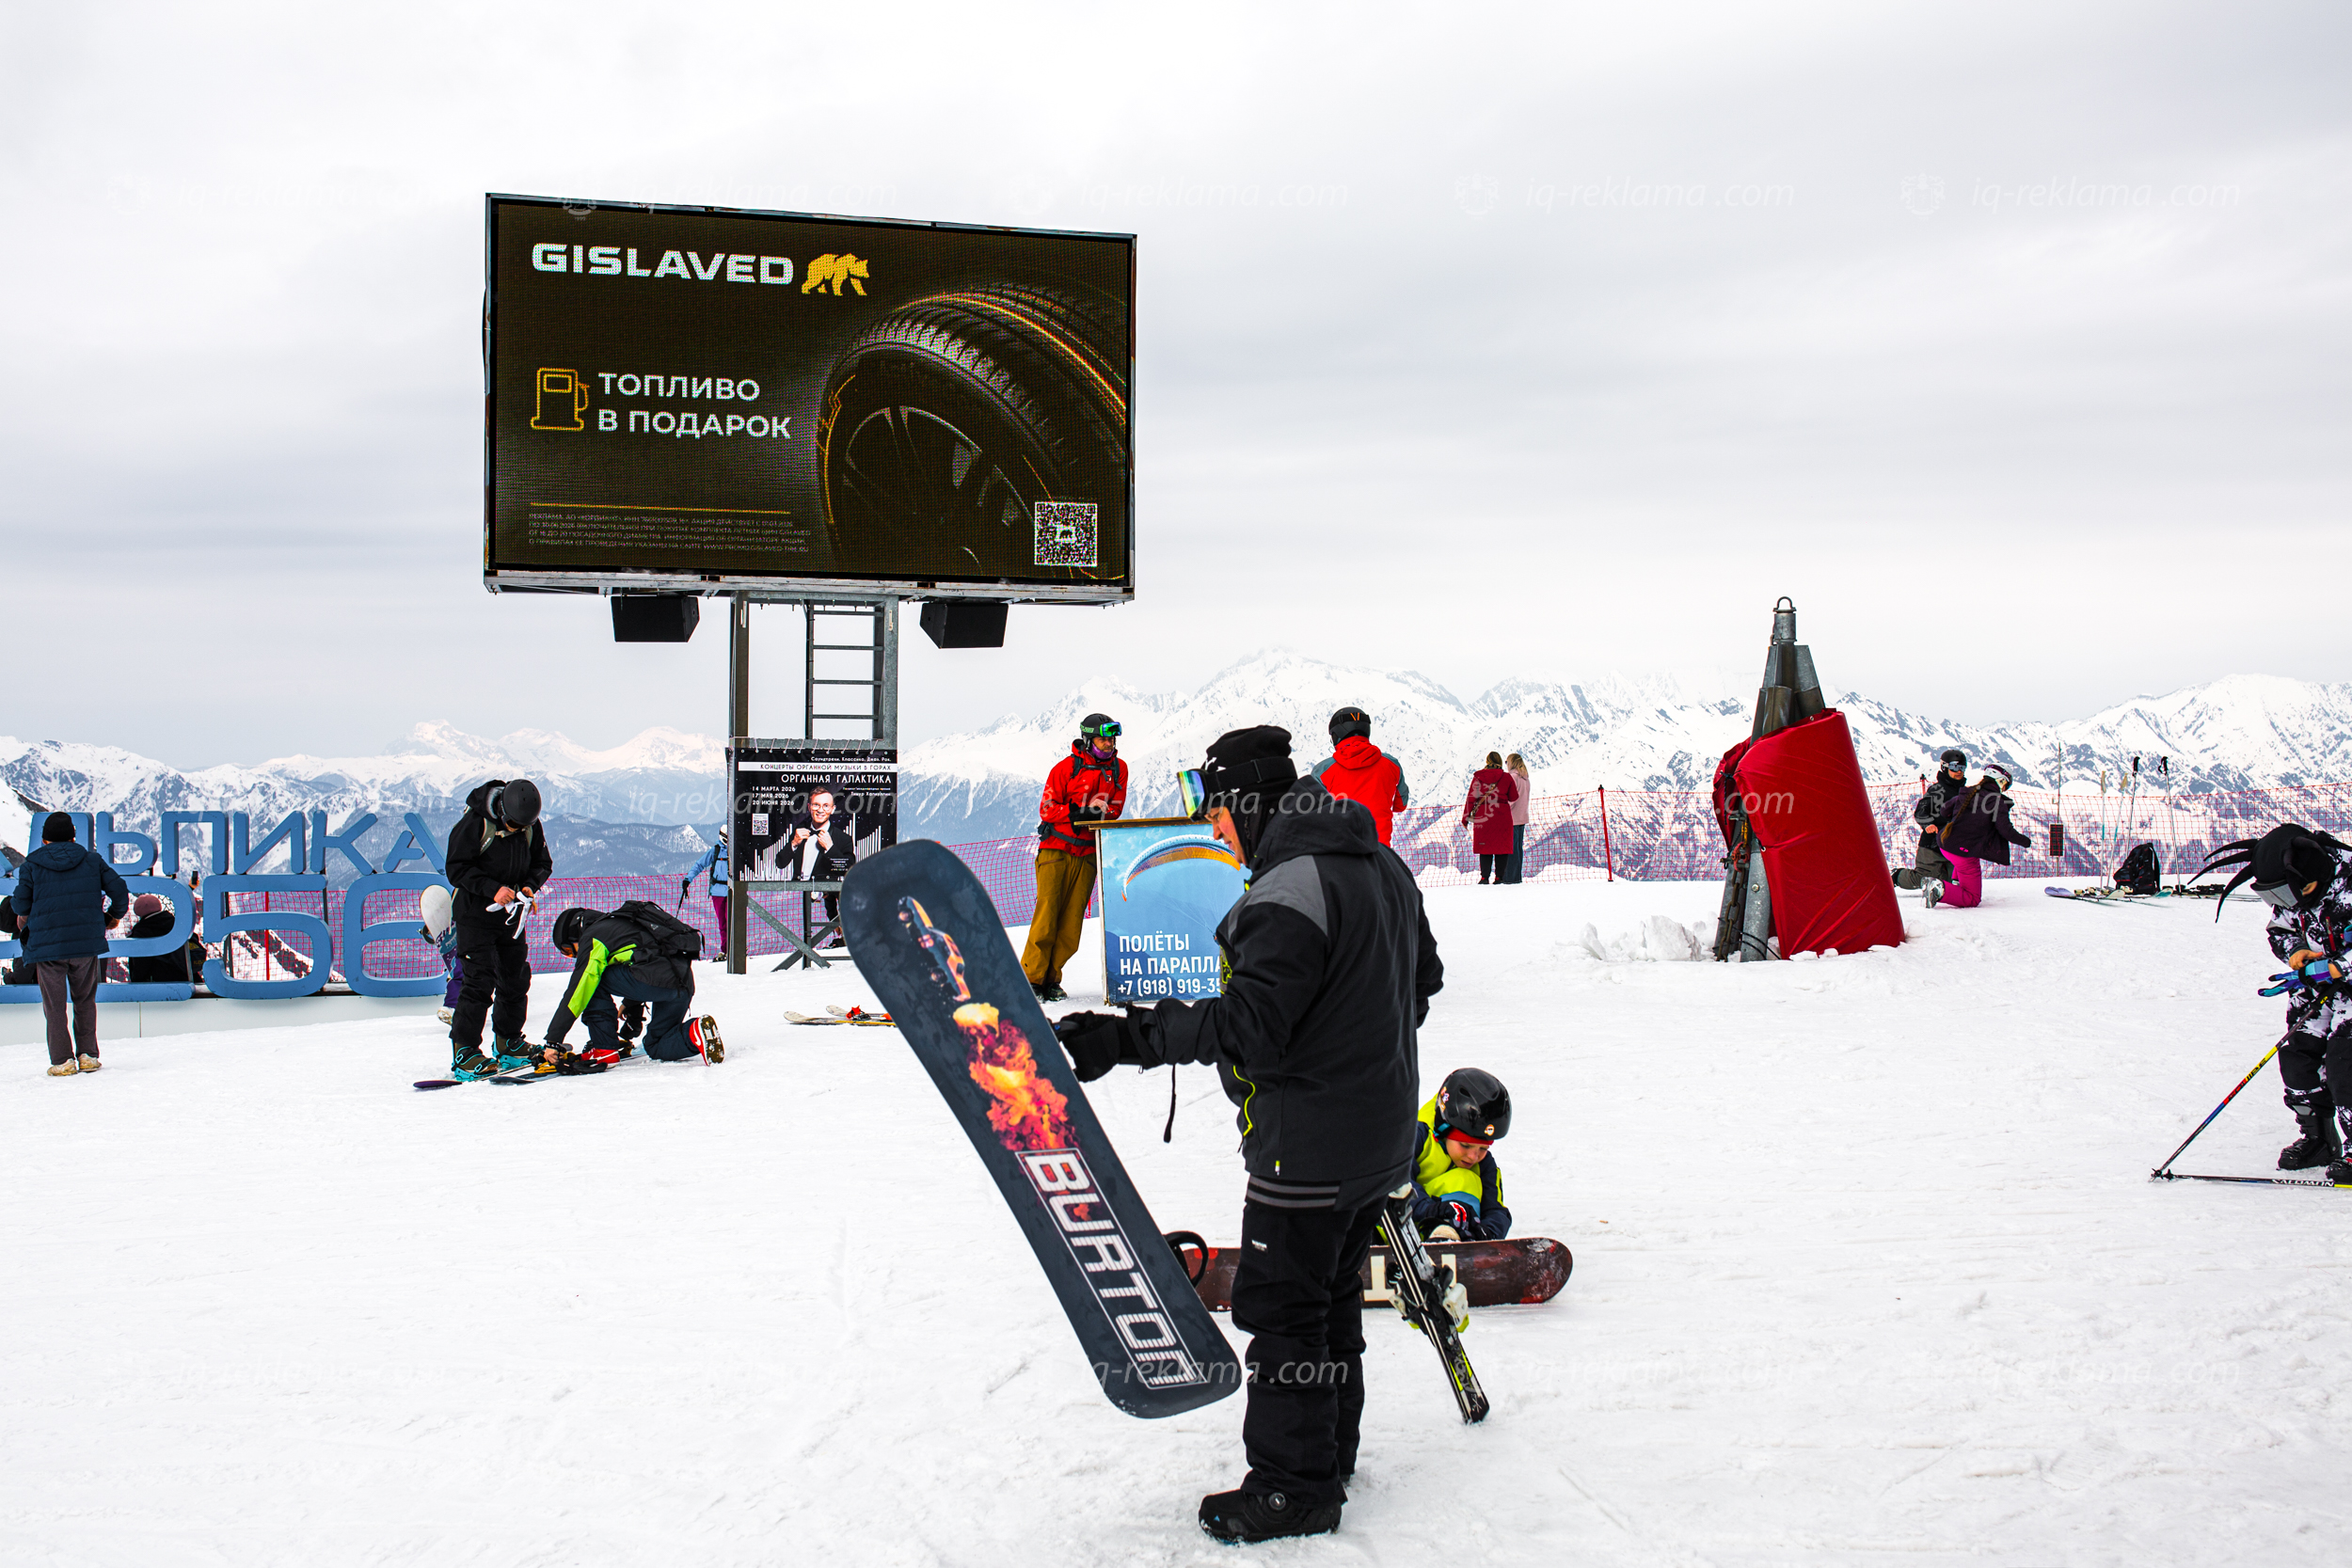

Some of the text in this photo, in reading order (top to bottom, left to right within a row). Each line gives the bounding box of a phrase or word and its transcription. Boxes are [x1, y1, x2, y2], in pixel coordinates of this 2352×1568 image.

[532, 243, 793, 285] GISLAVED
[597, 372, 761, 402] ТОПЛИВО
[597, 408, 791, 439] В ПОДАРОК
[781, 773, 892, 784] ОРГАННАЯ ГАЛАКТИКА
[796, 763, 833, 771] ОРГАННОЙ
[1118, 930, 1190, 953] ПОЛЁТЫ
[1120, 958, 1143, 975] НА
[1118, 981, 1133, 996] +7
[1137, 976, 1173, 997] (918)
[1024, 1152, 1198, 1386] BURTON
